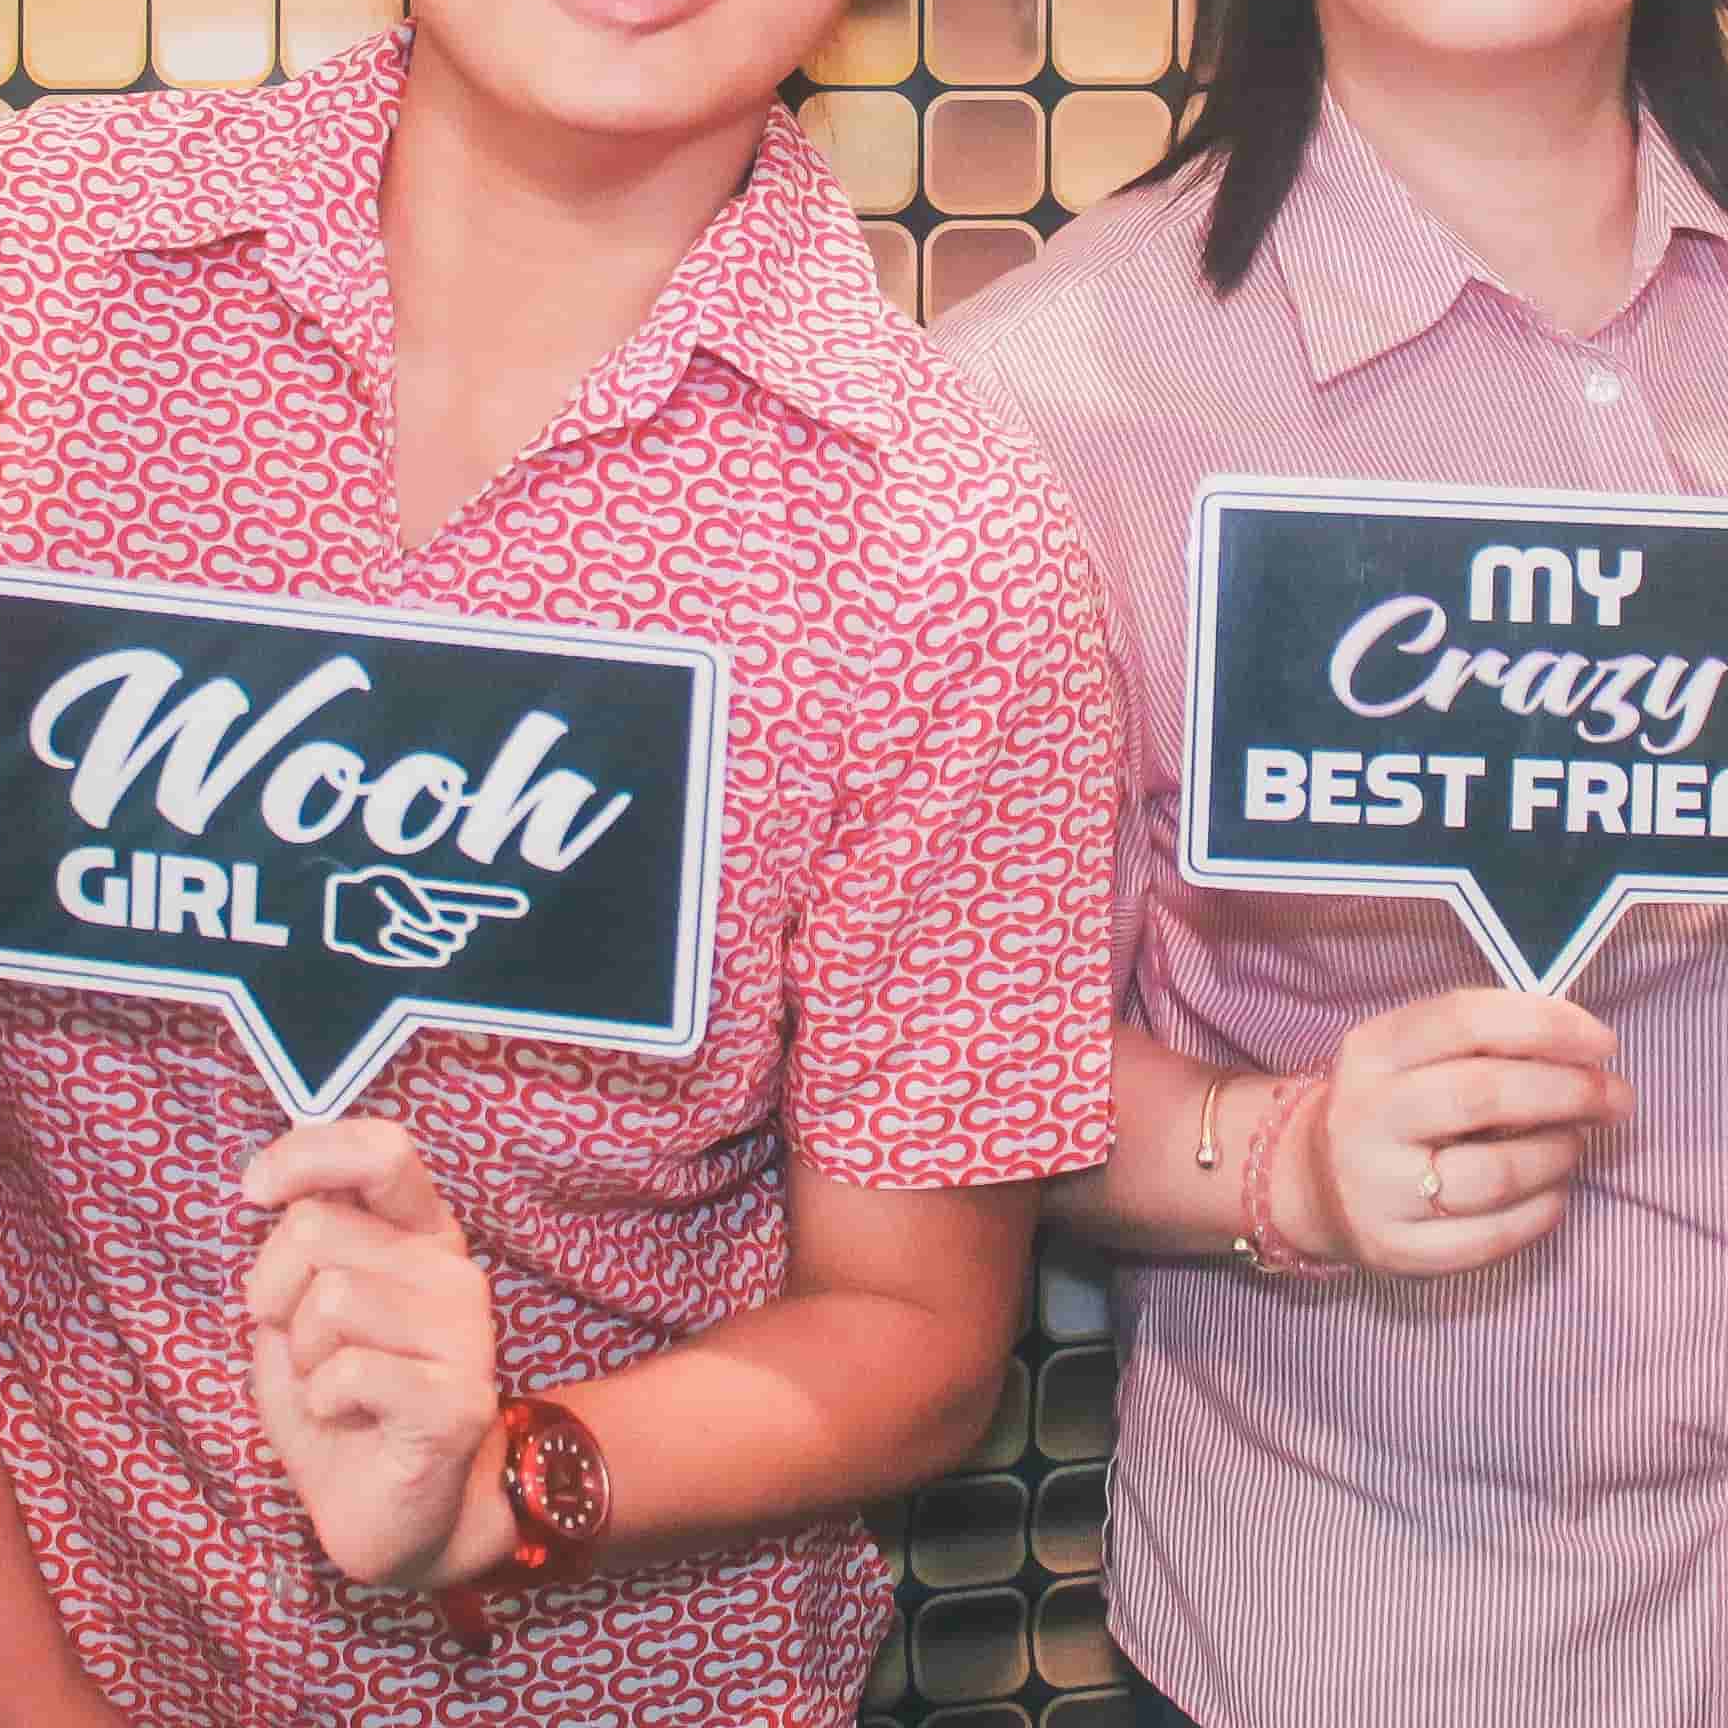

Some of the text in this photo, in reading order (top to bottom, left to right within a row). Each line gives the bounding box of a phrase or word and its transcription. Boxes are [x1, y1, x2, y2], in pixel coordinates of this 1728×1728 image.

[1469, 544, 1644, 627] MY
[1328, 594, 1728, 755] Crazy
[27, 647, 632, 872] Wooh
[1243, 747, 1486, 829] BEST
[54, 845, 290, 948] GIRL
